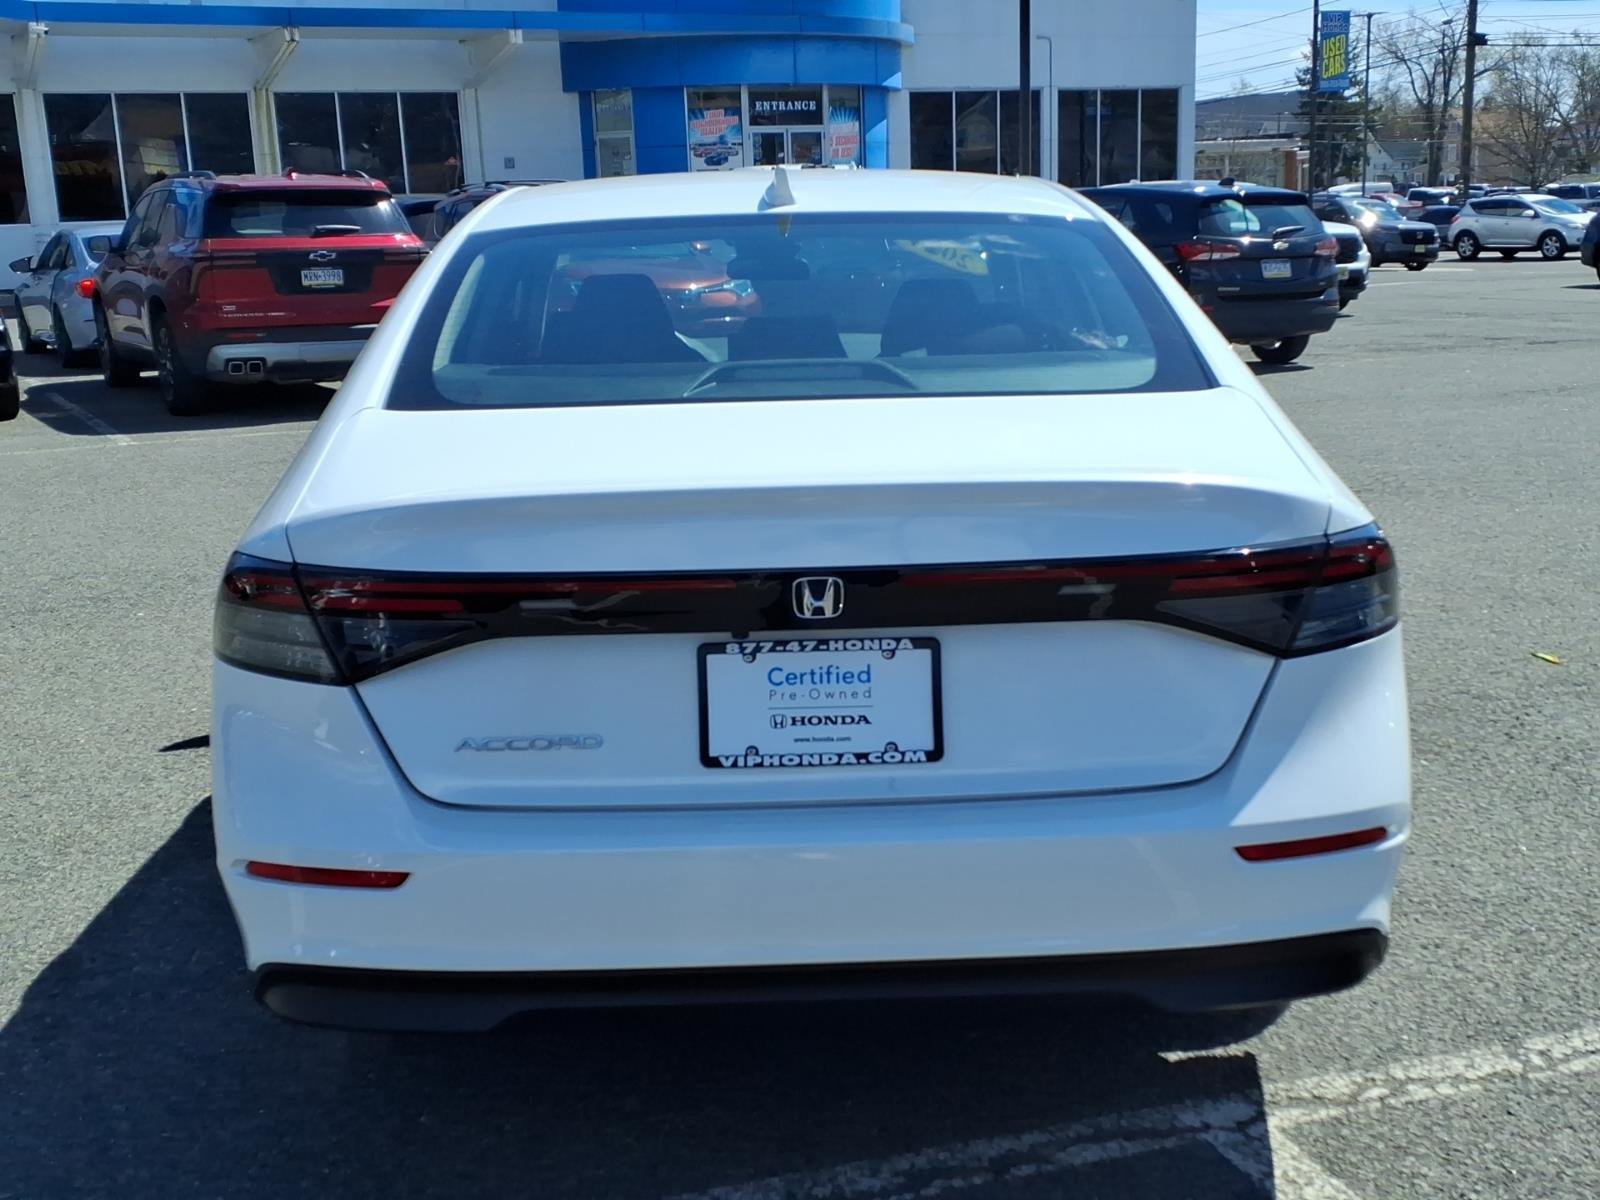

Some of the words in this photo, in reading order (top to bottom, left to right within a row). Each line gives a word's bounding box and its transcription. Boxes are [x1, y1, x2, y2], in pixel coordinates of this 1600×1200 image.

[1323, 34, 1346, 57] USED
[1323, 53, 1346, 79] CARS
[755, 100, 817, 111] ENTRANCE
[725, 638, 914, 654] 877-47-HONDA
[767, 664, 872, 686] Certified
[769, 687, 872, 701] Pre-Owned
[790, 714, 872, 727] HONDA
[454, 735, 604, 752] ACCORD
[717, 750, 928, 768] VIPHONDA.COM
